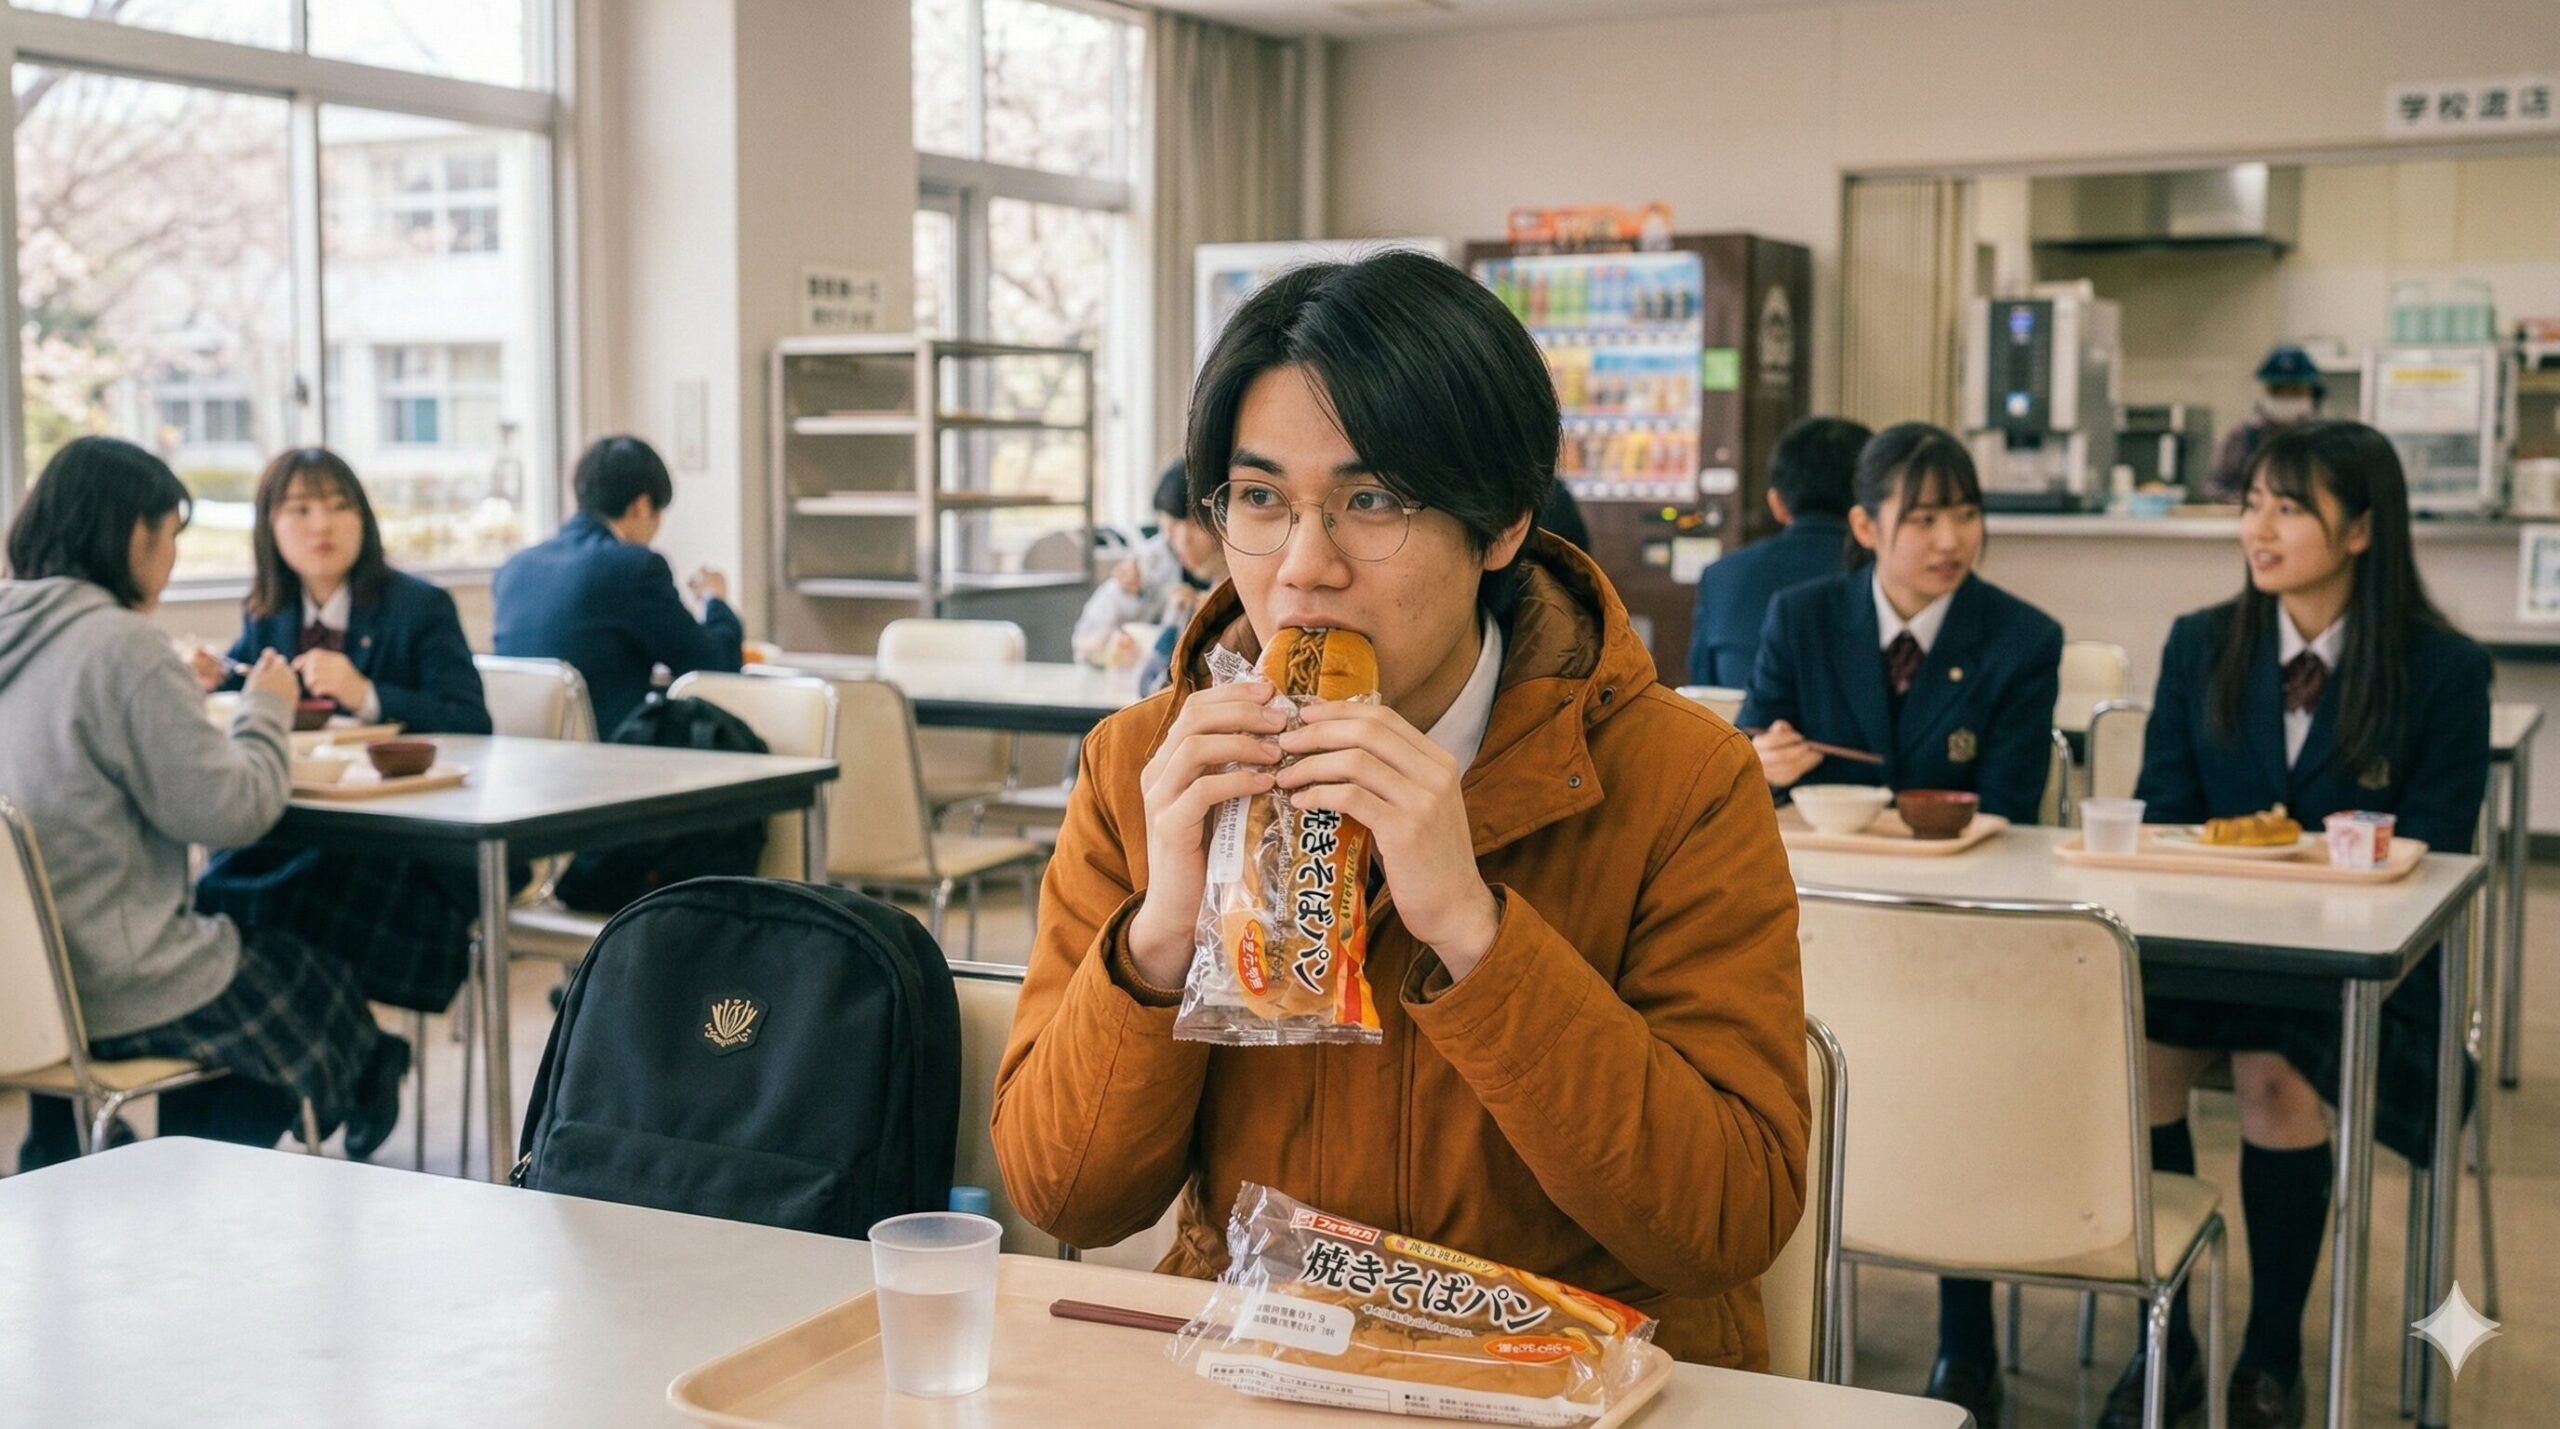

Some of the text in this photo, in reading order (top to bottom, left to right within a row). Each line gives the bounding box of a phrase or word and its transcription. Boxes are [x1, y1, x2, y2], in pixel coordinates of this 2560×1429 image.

[1302, 1242, 1547, 1330] 焼きそばパン
